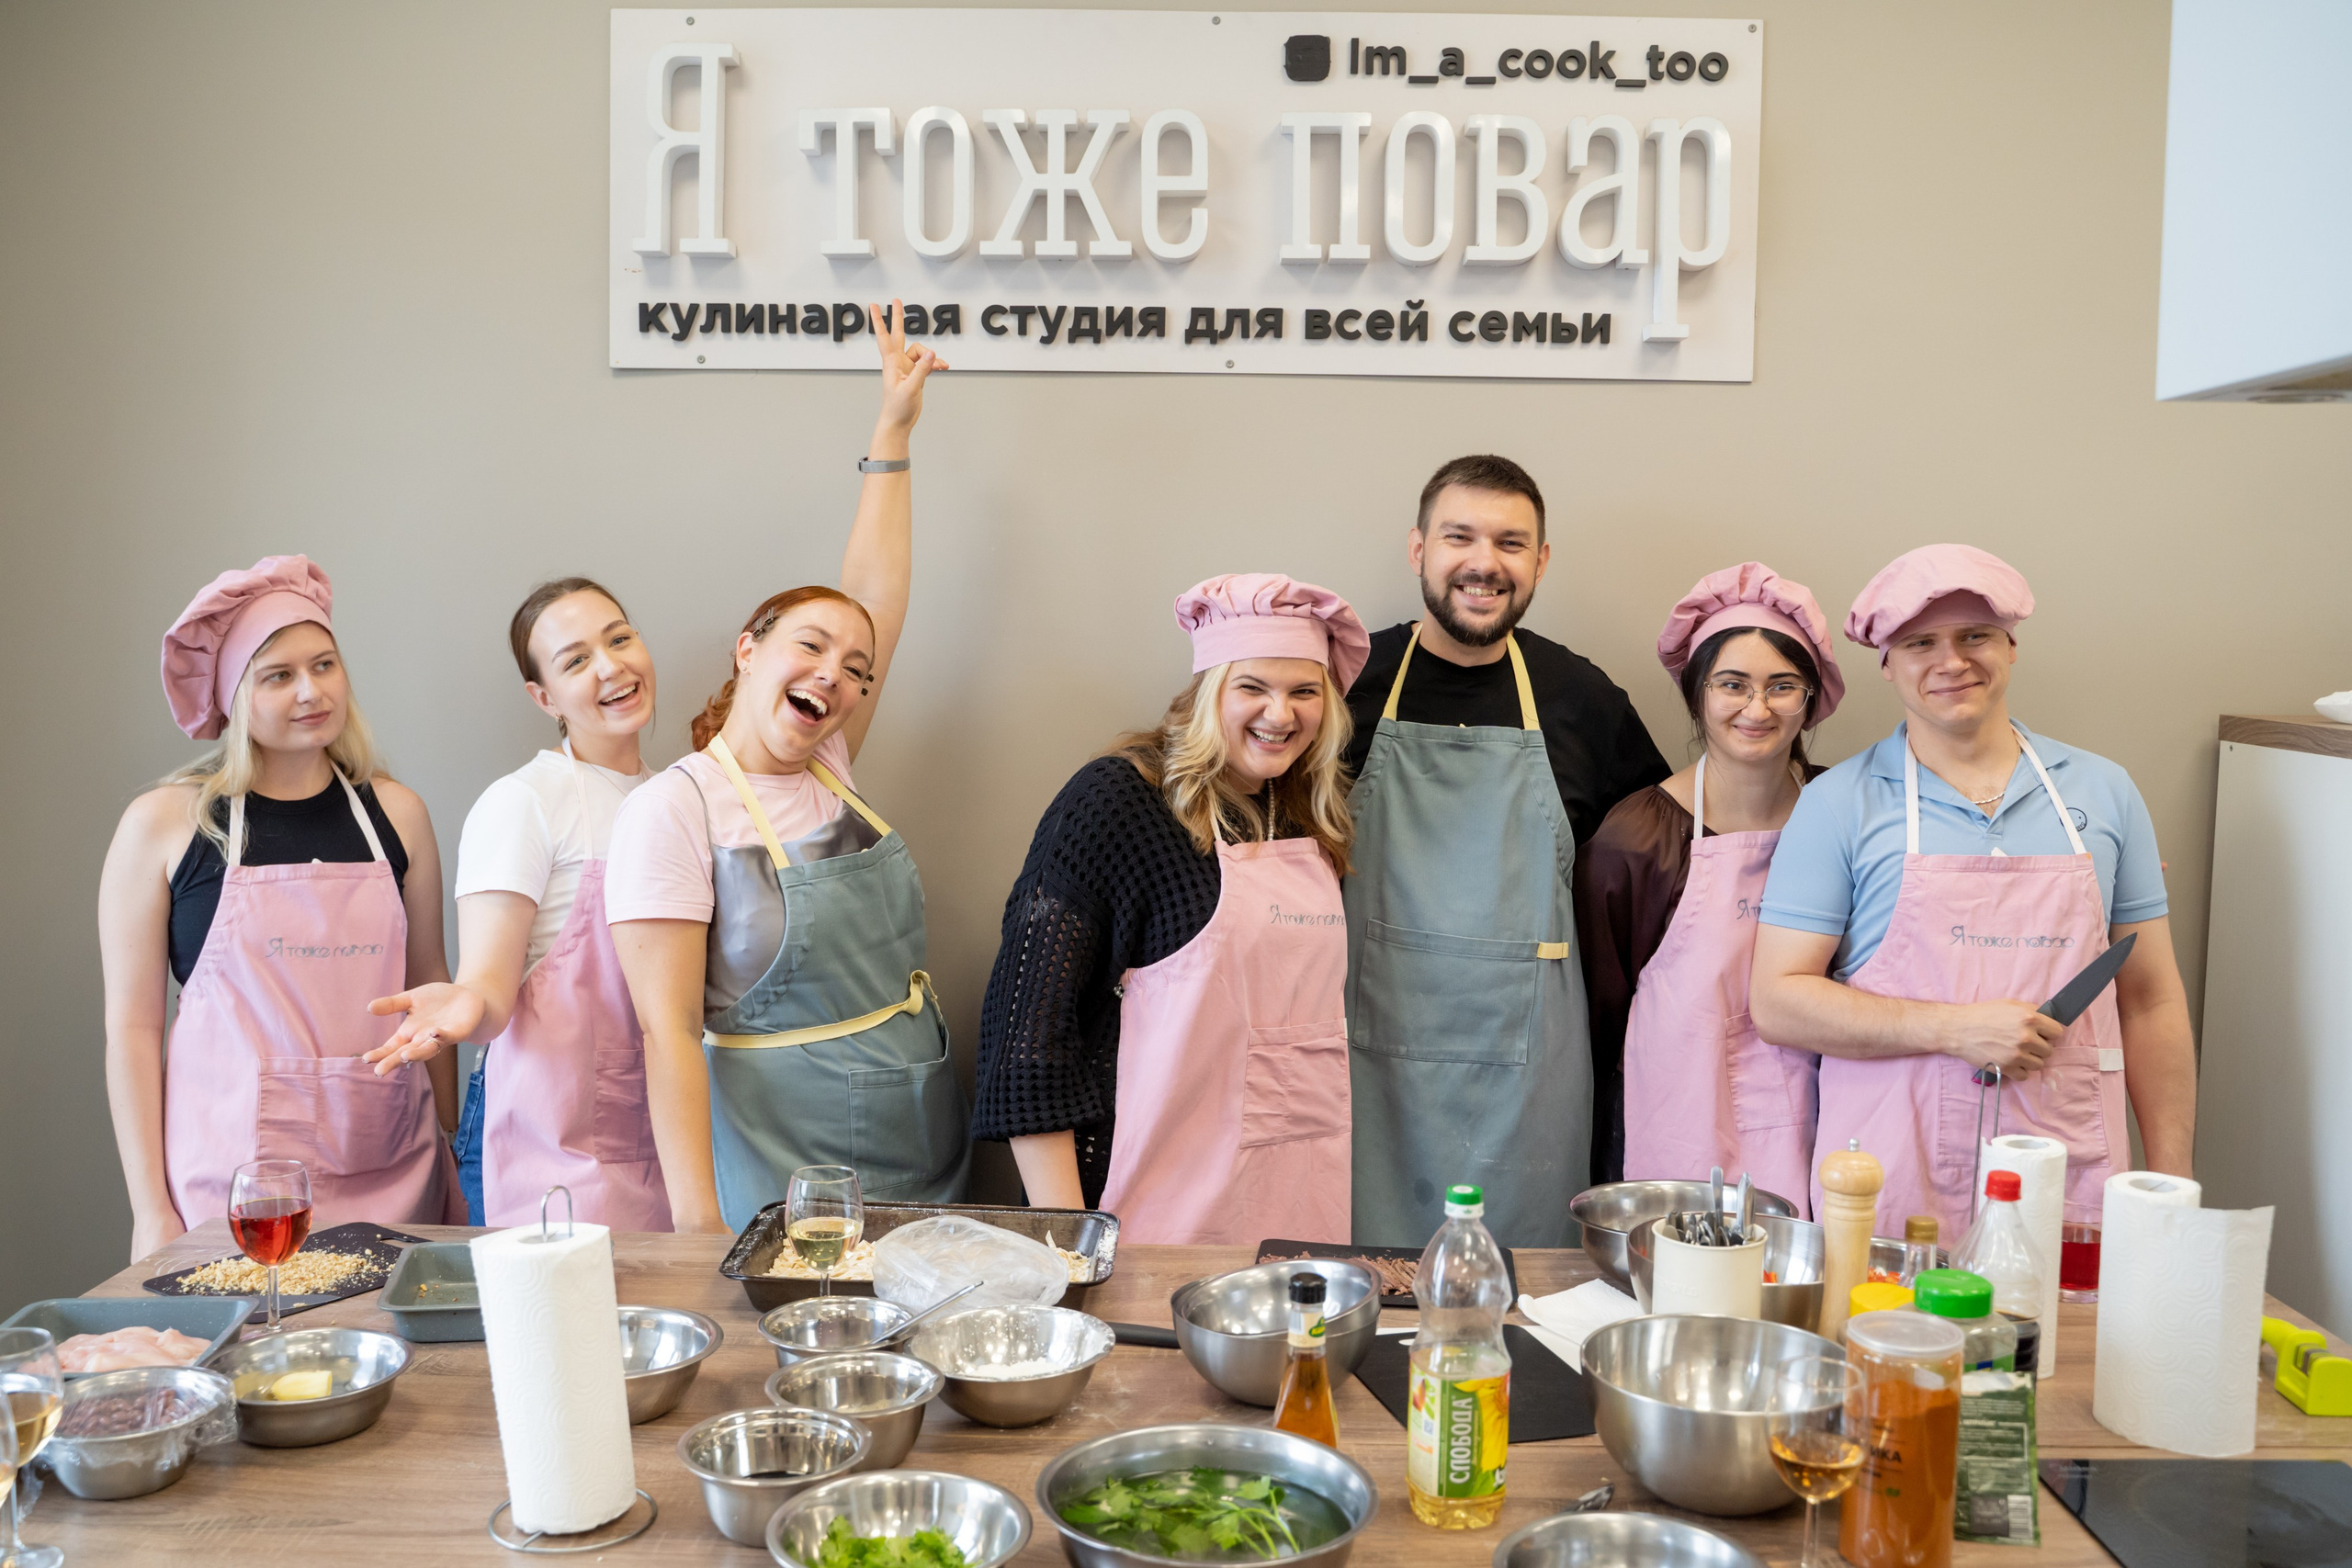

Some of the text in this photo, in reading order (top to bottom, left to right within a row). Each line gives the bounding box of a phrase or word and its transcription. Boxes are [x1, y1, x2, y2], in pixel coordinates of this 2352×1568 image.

[632, 43, 1732, 343] Я тоже повар
[980, 304, 1166, 345] студия
[1185, 306, 1283, 345] для
[1305, 299, 1429, 342] всей
[1448, 310, 1611, 344] семьи
[1270, 904, 1283, 924] Я
[1736, 898, 1750, 919] Я
[266, 936, 284, 958] Я
[1949, 924, 1965, 946] Я
[1968, 935, 2013, 948] тоже
[1449, 1396, 1474, 1484] СЛОБОДА
